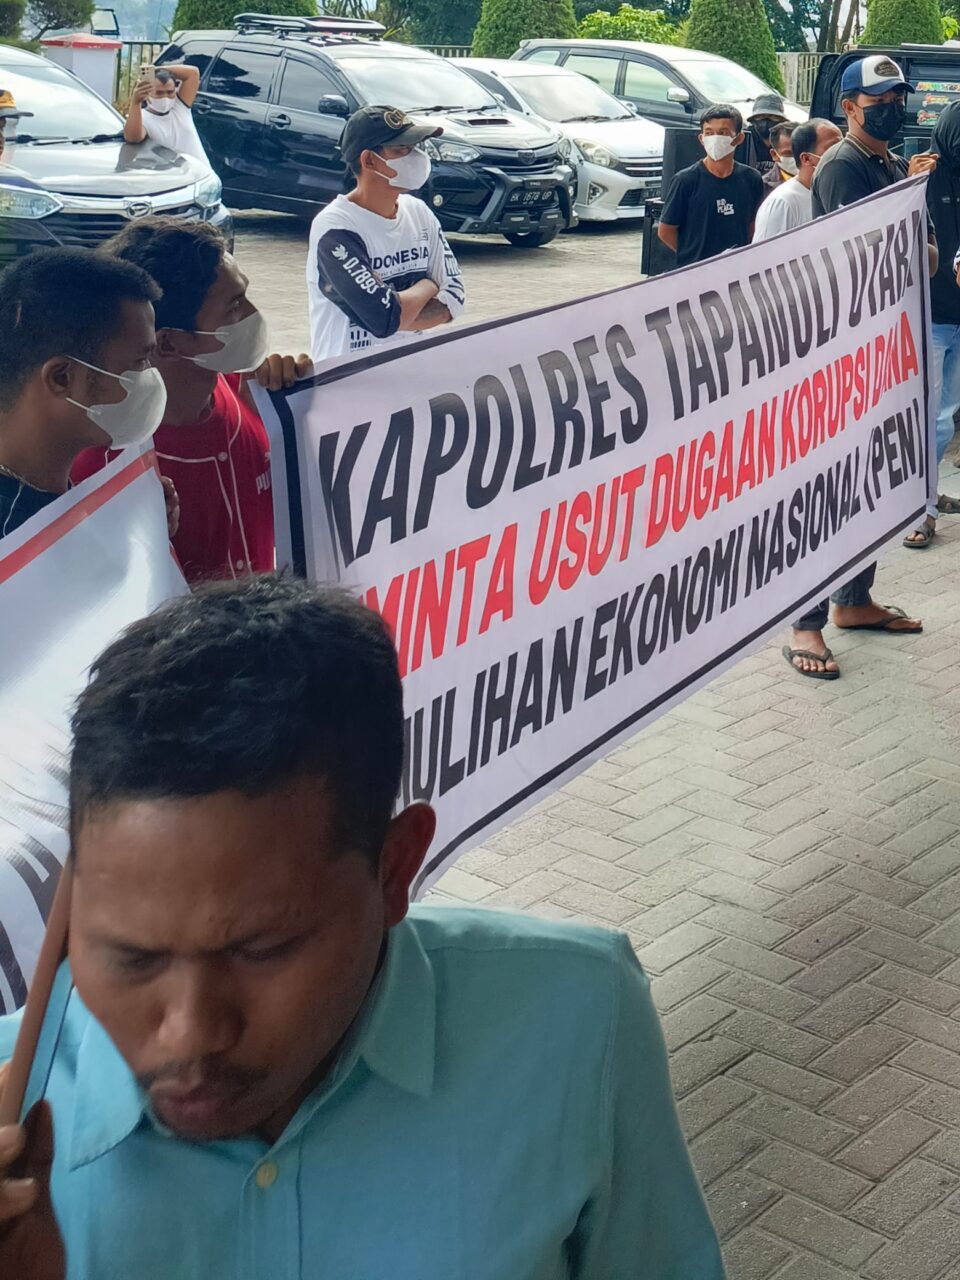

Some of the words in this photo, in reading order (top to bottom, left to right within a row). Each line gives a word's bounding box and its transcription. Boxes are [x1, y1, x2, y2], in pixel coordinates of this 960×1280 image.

[319, 323, 649, 568] KAPOLRES
[645, 247, 840, 426] TAPANULI
[372, 246, 429, 270] DONESIA
[255, 469, 271, 496] PU
[363, 523, 517, 680] MINTA
[529, 465, 645, 606] USUT
[644, 399, 778, 547] DUGAAN
[781, 342, 870, 468] KORUPSI
[400, 624, 582, 807] ULIHAN
[584, 524, 743, 700] EKONOMI
[745, 447, 861, 595] NASIONAL
[864, 398, 923, 513] (PEN)
